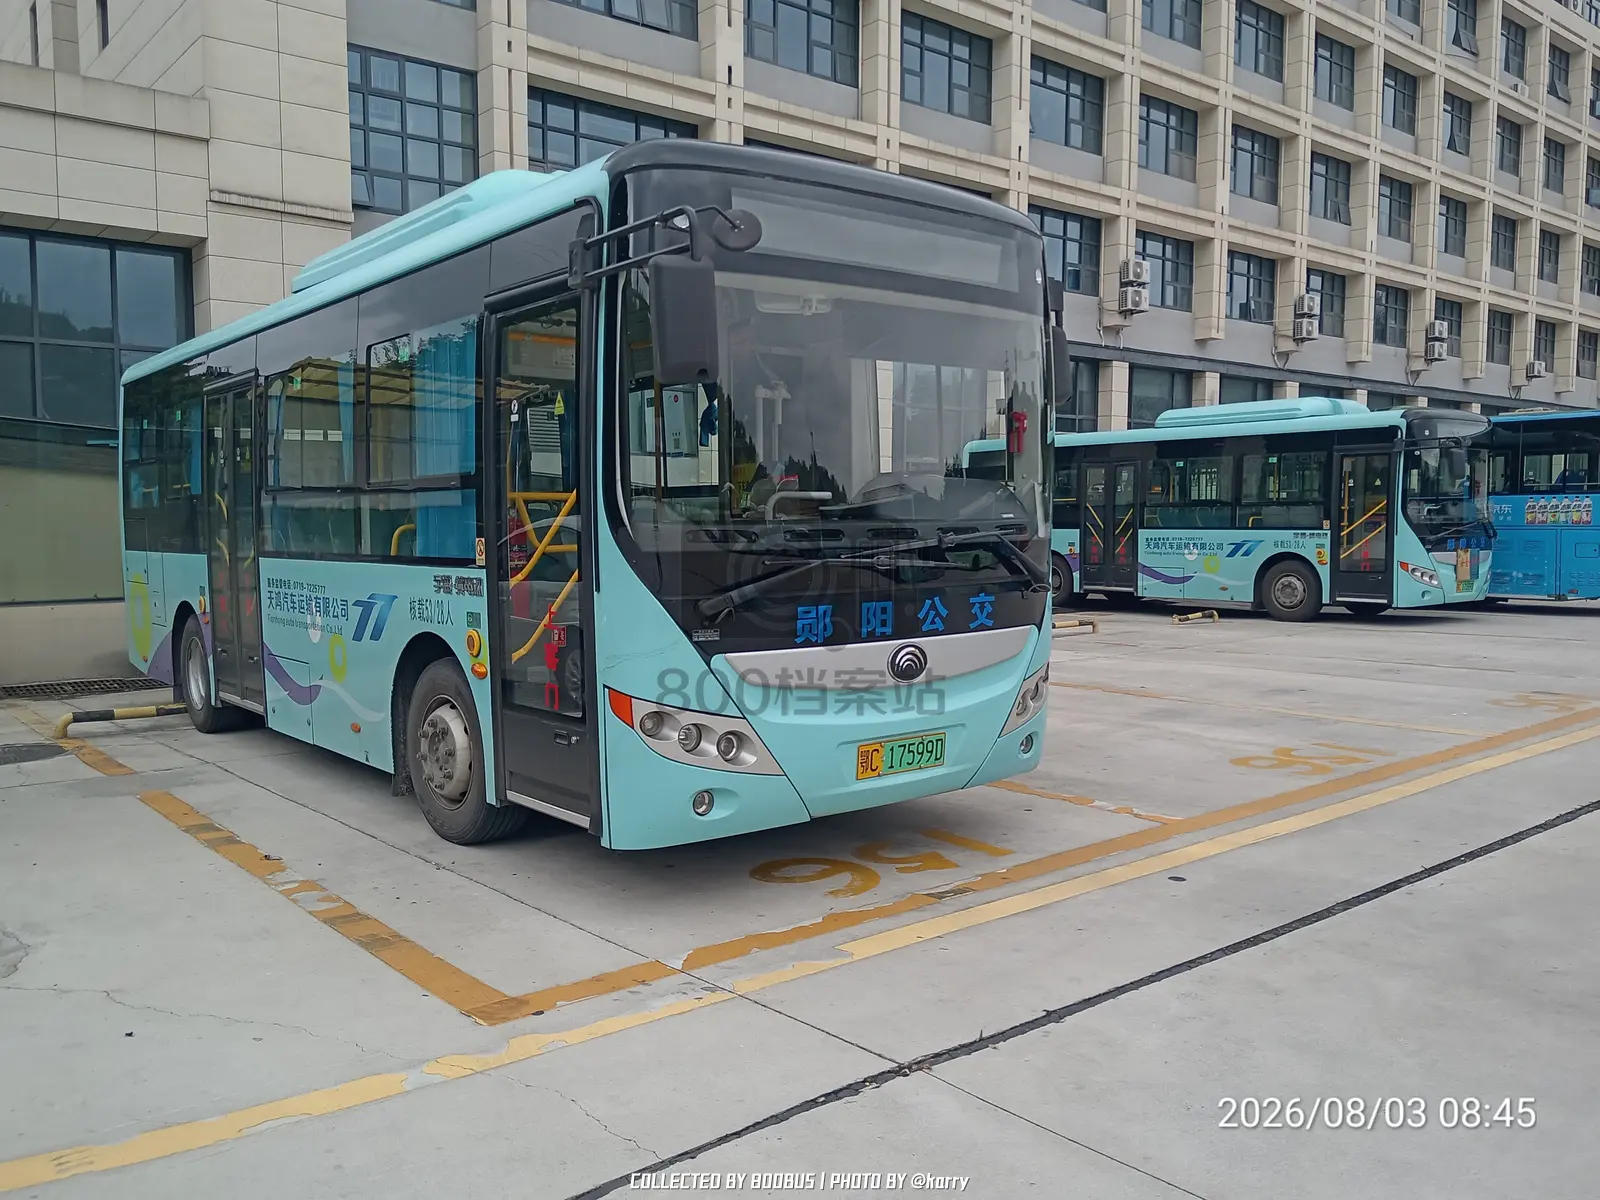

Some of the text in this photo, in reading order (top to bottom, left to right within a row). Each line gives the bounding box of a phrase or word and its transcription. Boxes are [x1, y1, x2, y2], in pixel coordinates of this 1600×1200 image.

[267, 590, 349, 621] 天鸿汽车运输有限公司
[794, 593, 995, 643] 郧阳公交
[860, 738, 944, 774] 鄂C 17599D
